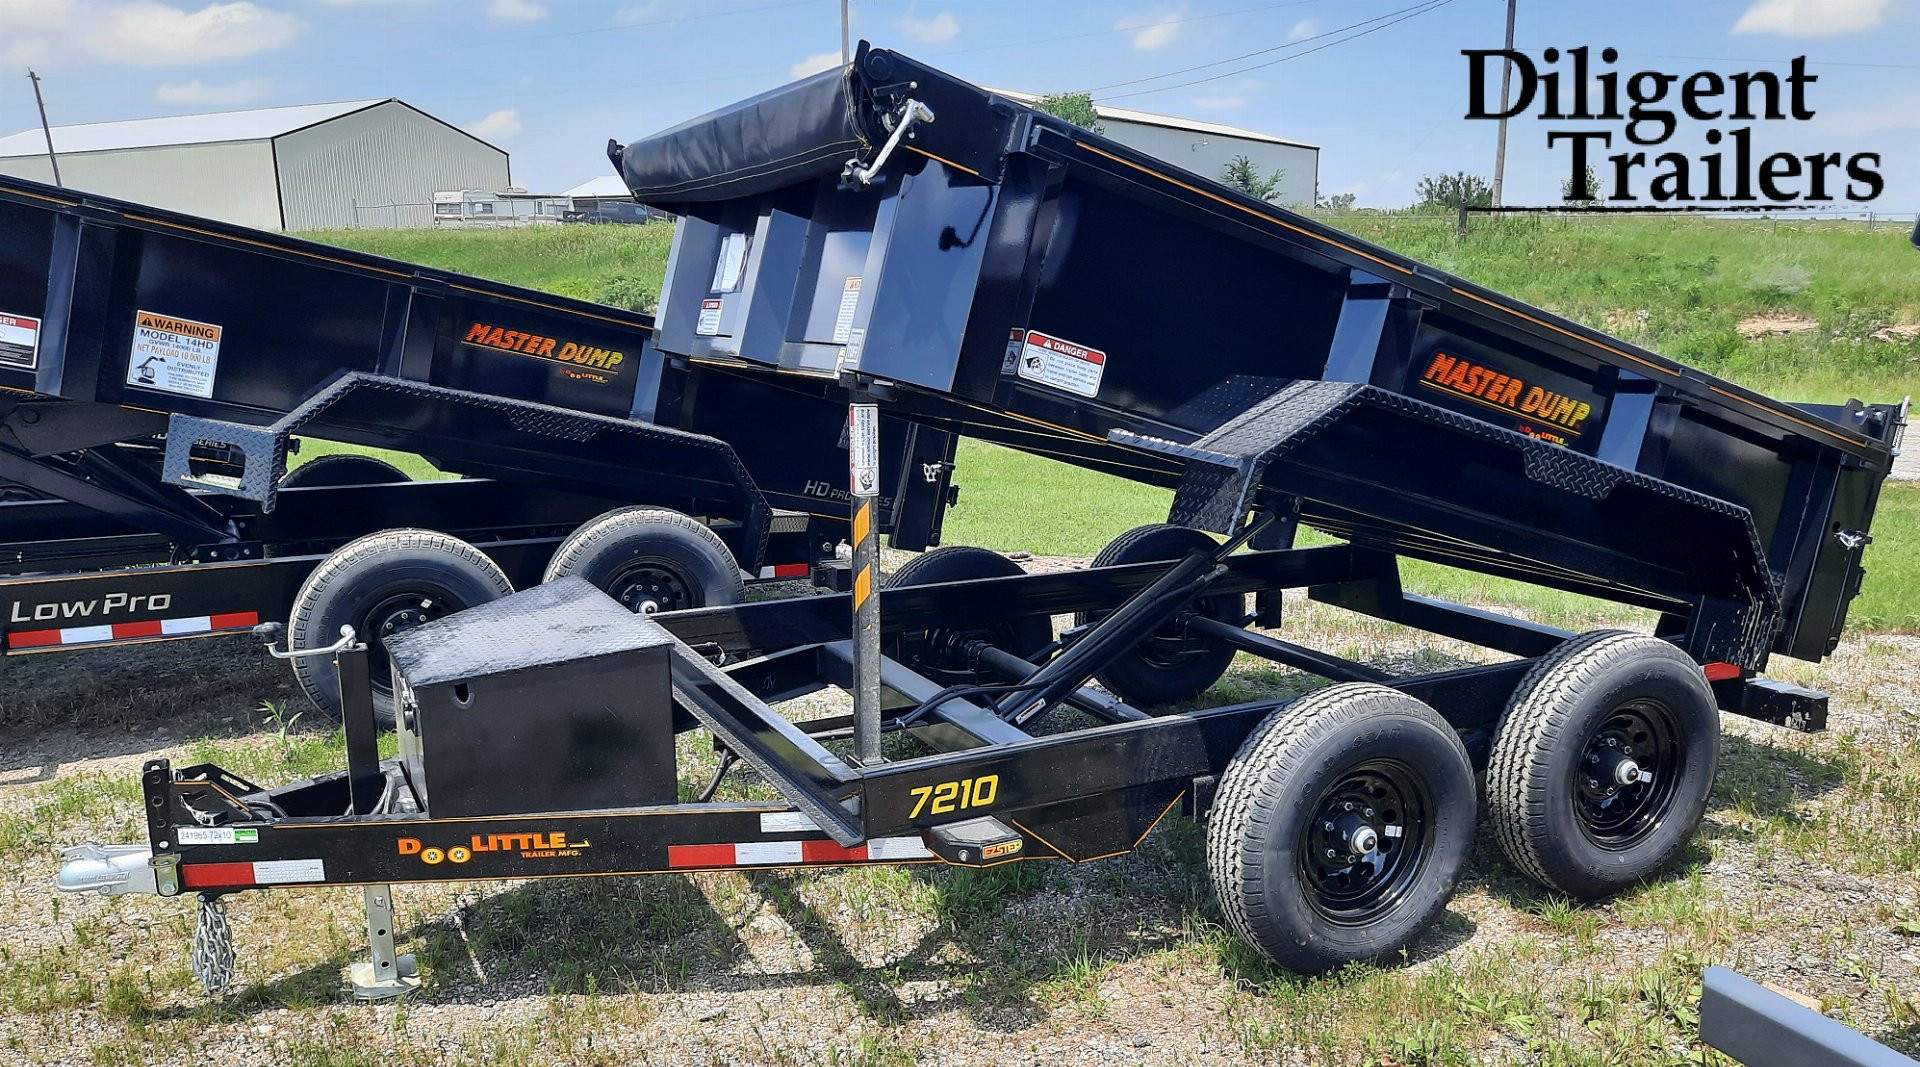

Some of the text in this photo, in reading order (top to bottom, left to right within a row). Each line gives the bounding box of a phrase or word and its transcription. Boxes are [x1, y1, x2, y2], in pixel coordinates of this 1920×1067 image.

[154, 318, 214, 339] WARNING
[140, 329, 214, 350] MODEL 14HD
[465, 322, 624, 370] MASTER DUMP
[137, 343, 149, 352] NET
[151, 345, 179, 358] PAYLOAD
[1053, 342, 1088, 360] DANGER
[166, 365, 210, 378] DISTRIBUTED
[176, 362, 201, 370] EVENLY
[1424, 352, 1592, 427] MASTER DUMP
[804, 480, 831, 497] HD
[908, 774, 999, 819] 7210
[519, 849, 582, 859] TRAILER MFG.
